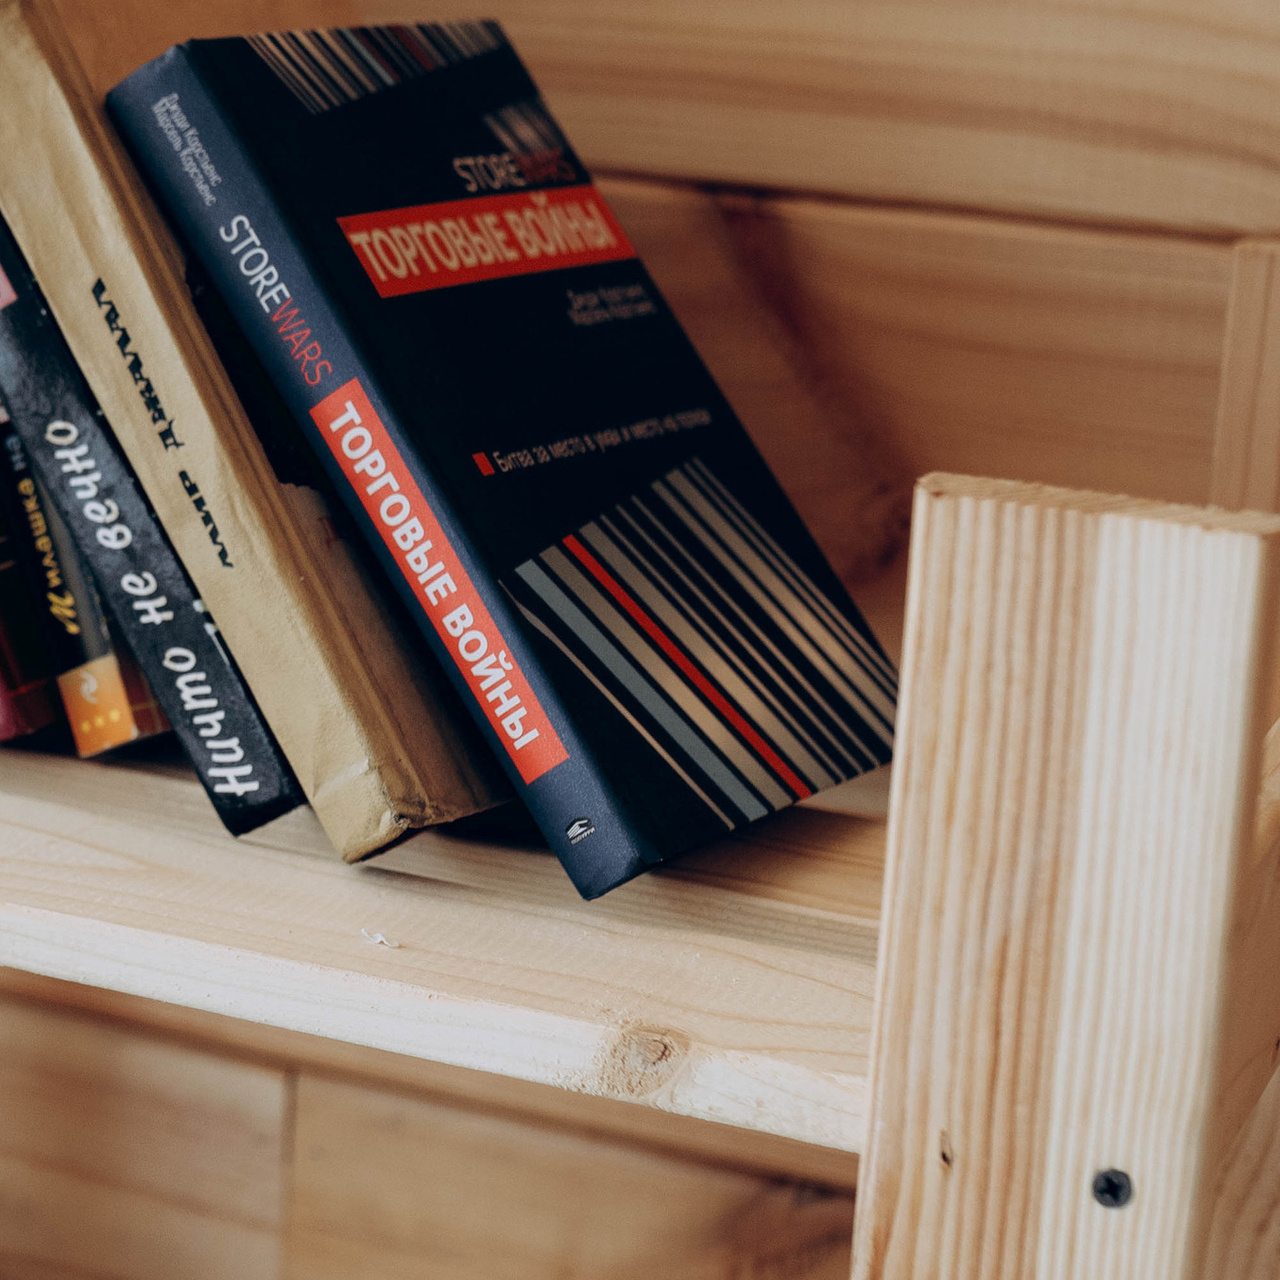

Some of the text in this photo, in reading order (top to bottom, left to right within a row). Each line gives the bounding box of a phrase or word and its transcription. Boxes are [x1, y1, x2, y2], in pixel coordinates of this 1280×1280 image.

[348, 191, 616, 282] ТОРГОВЫЕ ВОЙНЫ
[493, 449, 535, 472] Битва
[18, 476, 80, 635] Милашка
[45, 420, 260, 796] Ничто не вечно
[324, 401, 540, 751] ТОРГОВЫЕ ВОЙНЫ
